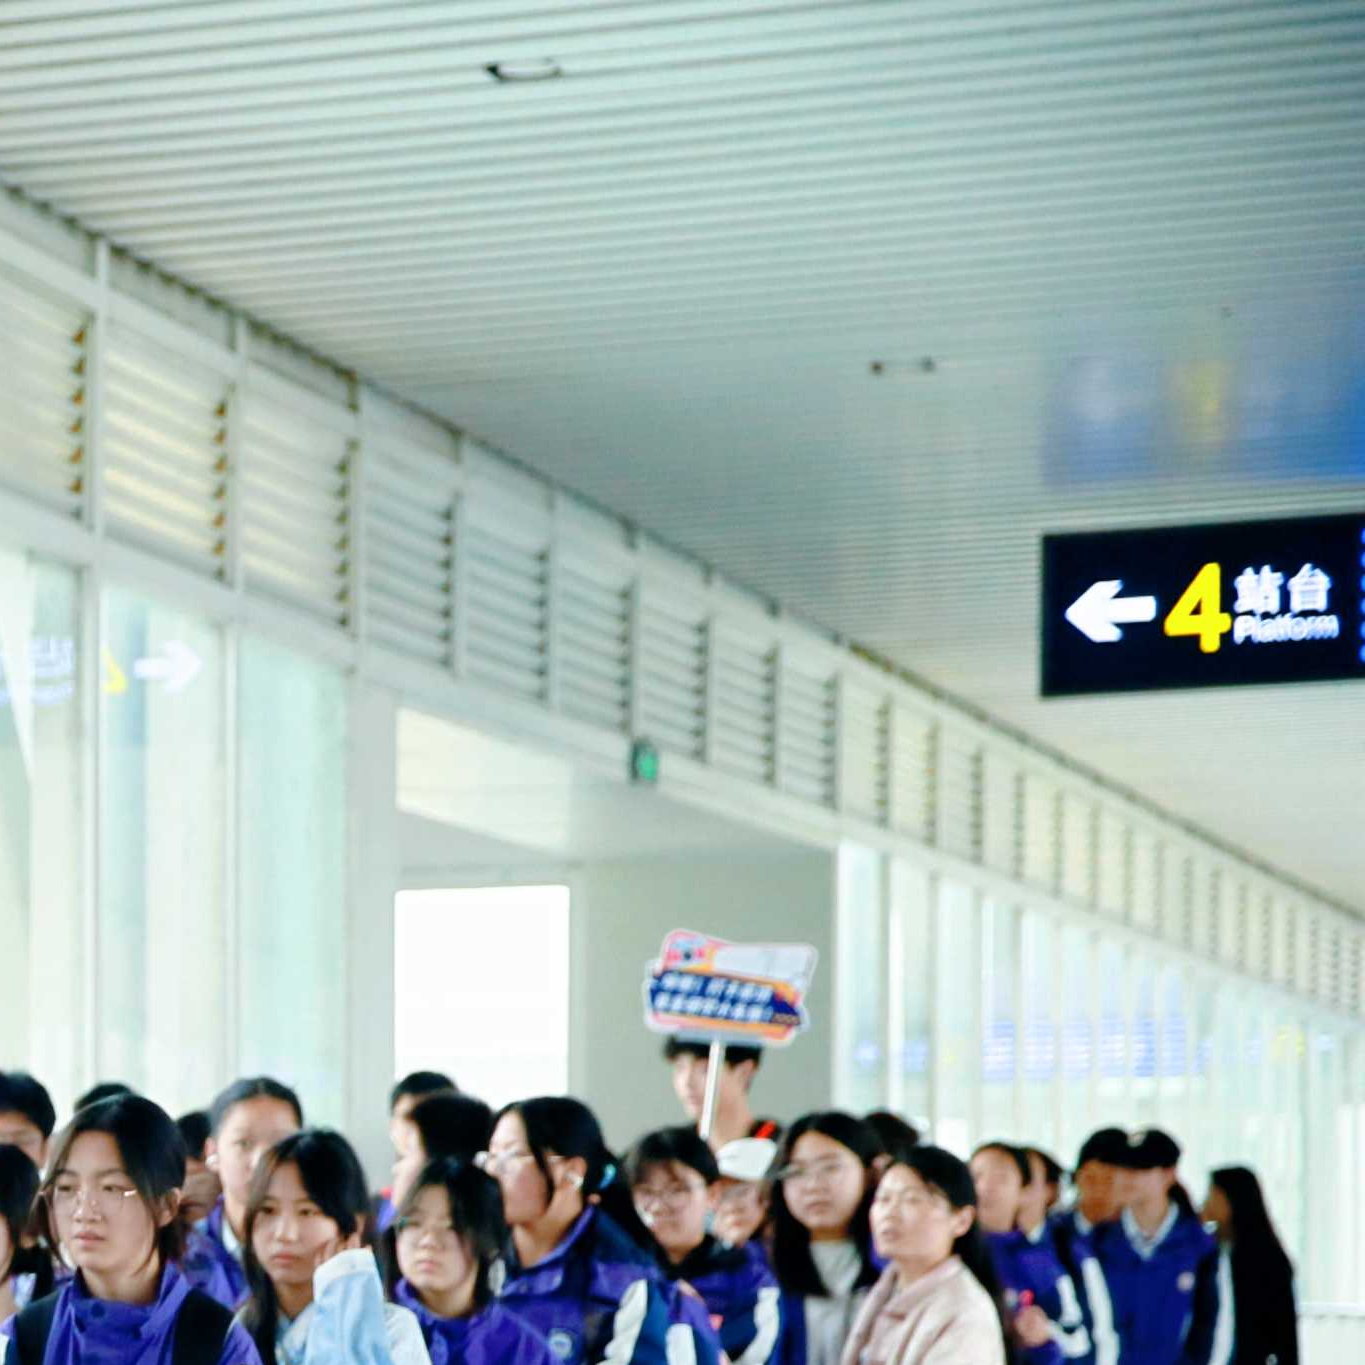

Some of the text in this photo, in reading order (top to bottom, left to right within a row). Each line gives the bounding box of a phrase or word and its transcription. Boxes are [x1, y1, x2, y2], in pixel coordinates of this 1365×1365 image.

[1163, 561, 1331, 653] 4 站台
[1233, 612, 1340, 645] Platform
